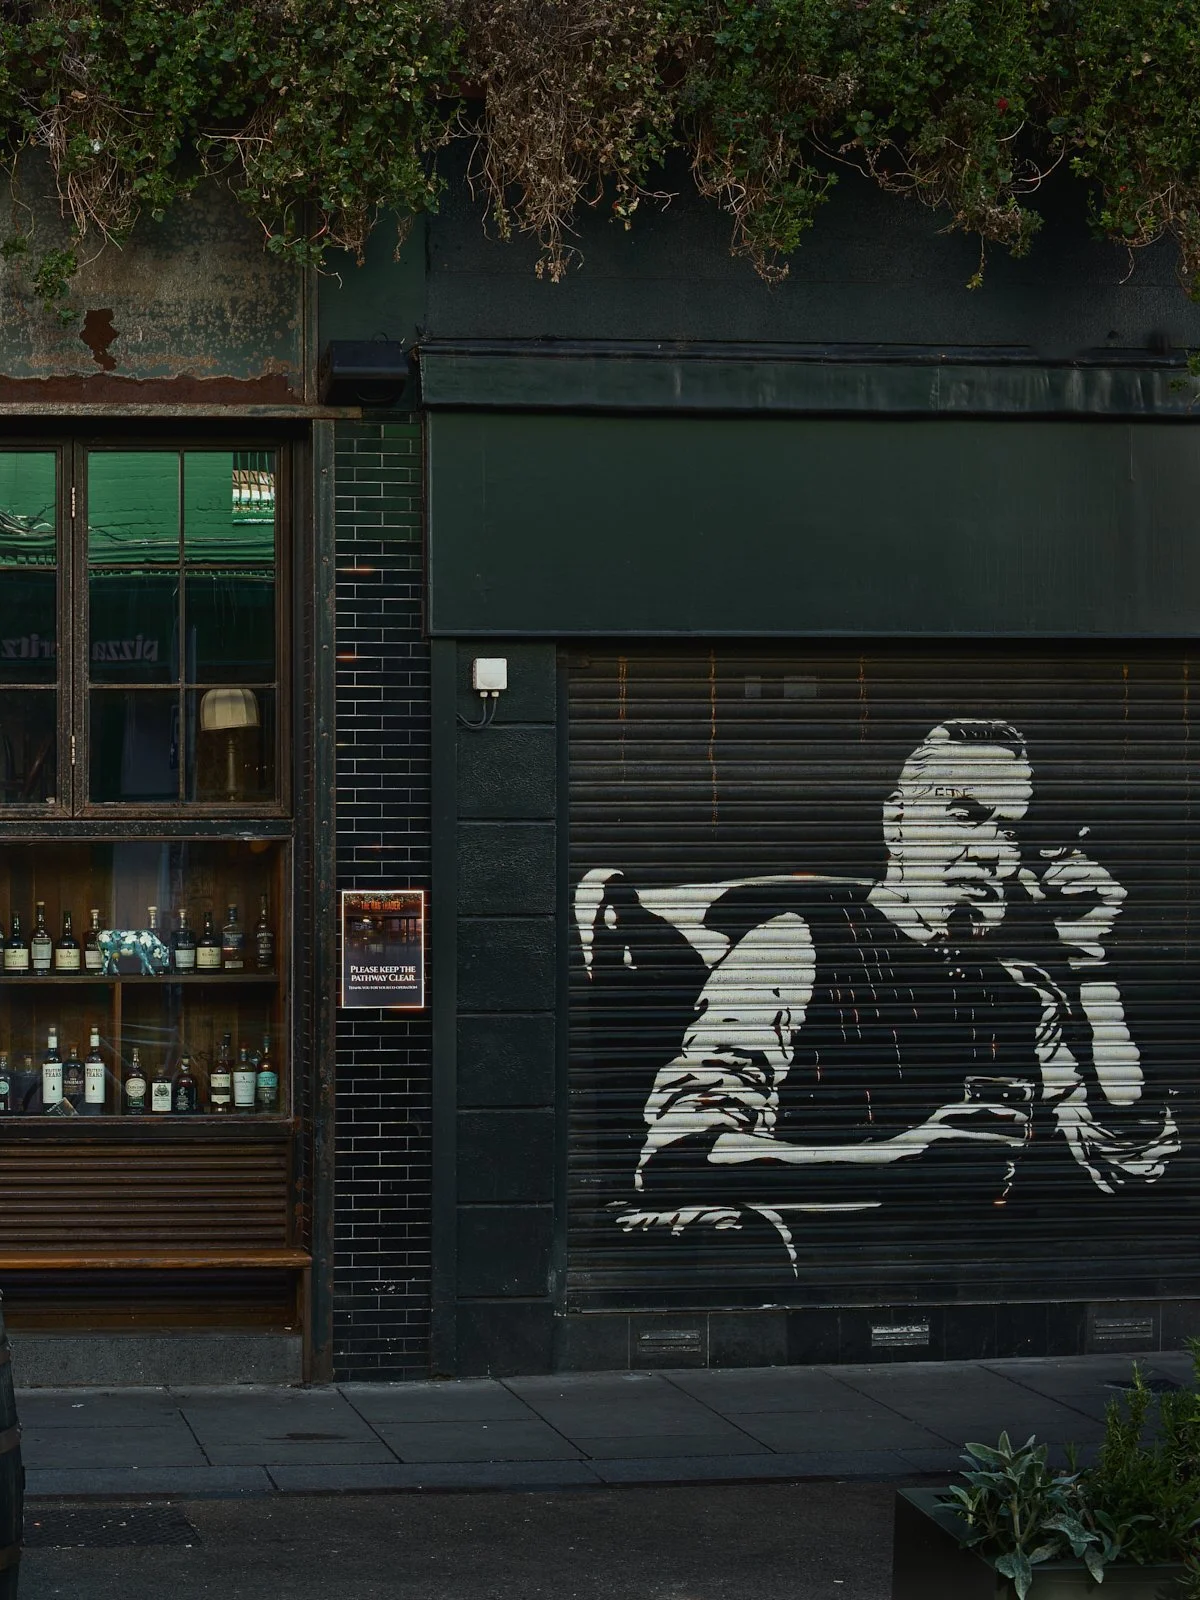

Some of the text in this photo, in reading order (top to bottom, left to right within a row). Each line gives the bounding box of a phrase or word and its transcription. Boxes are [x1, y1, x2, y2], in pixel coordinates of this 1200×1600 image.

[379, 965, 400, 973] KEEP
[400, 965, 417, 973] THE
[351, 974, 388, 982] PATHWAY
